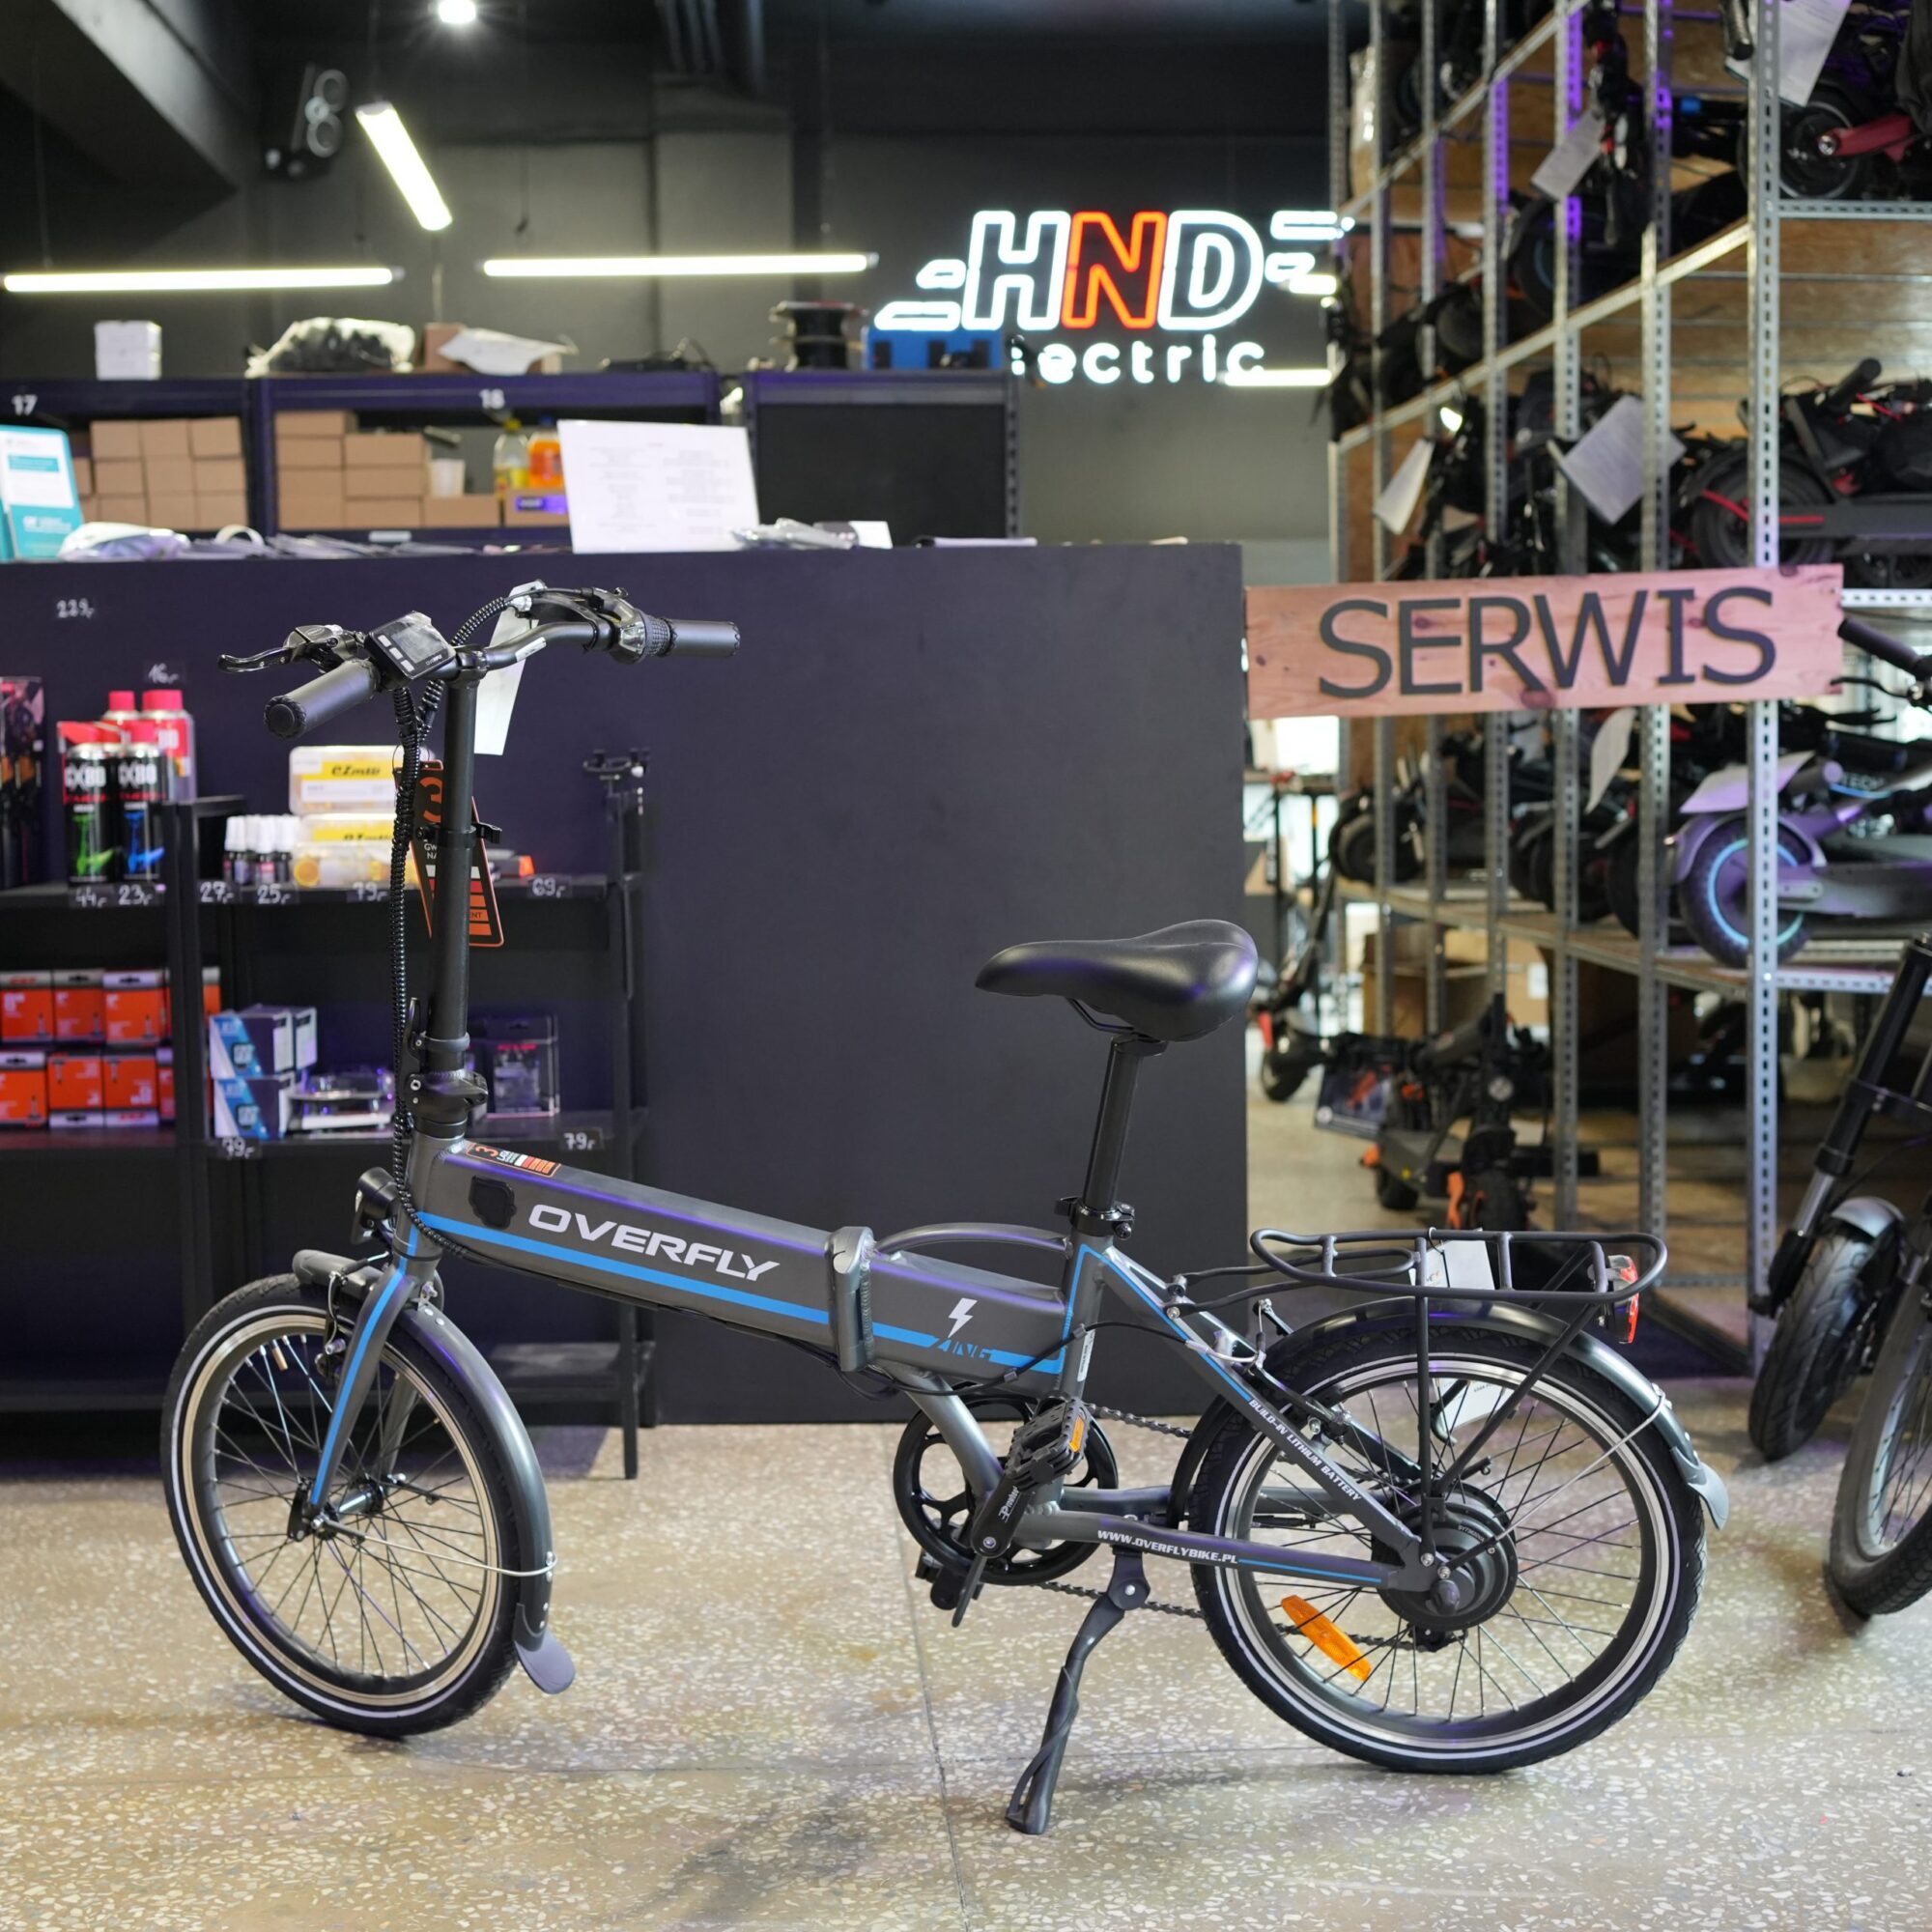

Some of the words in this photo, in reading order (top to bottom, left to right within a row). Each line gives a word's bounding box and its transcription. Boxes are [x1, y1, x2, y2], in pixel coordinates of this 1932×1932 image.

[961, 211, 1264, 330] HND
[12, 394, 38, 416] 17
[1319, 585, 1777, 699] SERWIS
[528, 1204, 781, 1282] OVERFLY
[1248, 1399, 1288, 1435] BUILD-IN
[1286, 1434, 1322, 1466] LITHIUM
[1321, 1465, 1362, 1500] BATTERY
[1097, 1529, 1238, 1564] WWW.OVERFLYBIKE.PL
